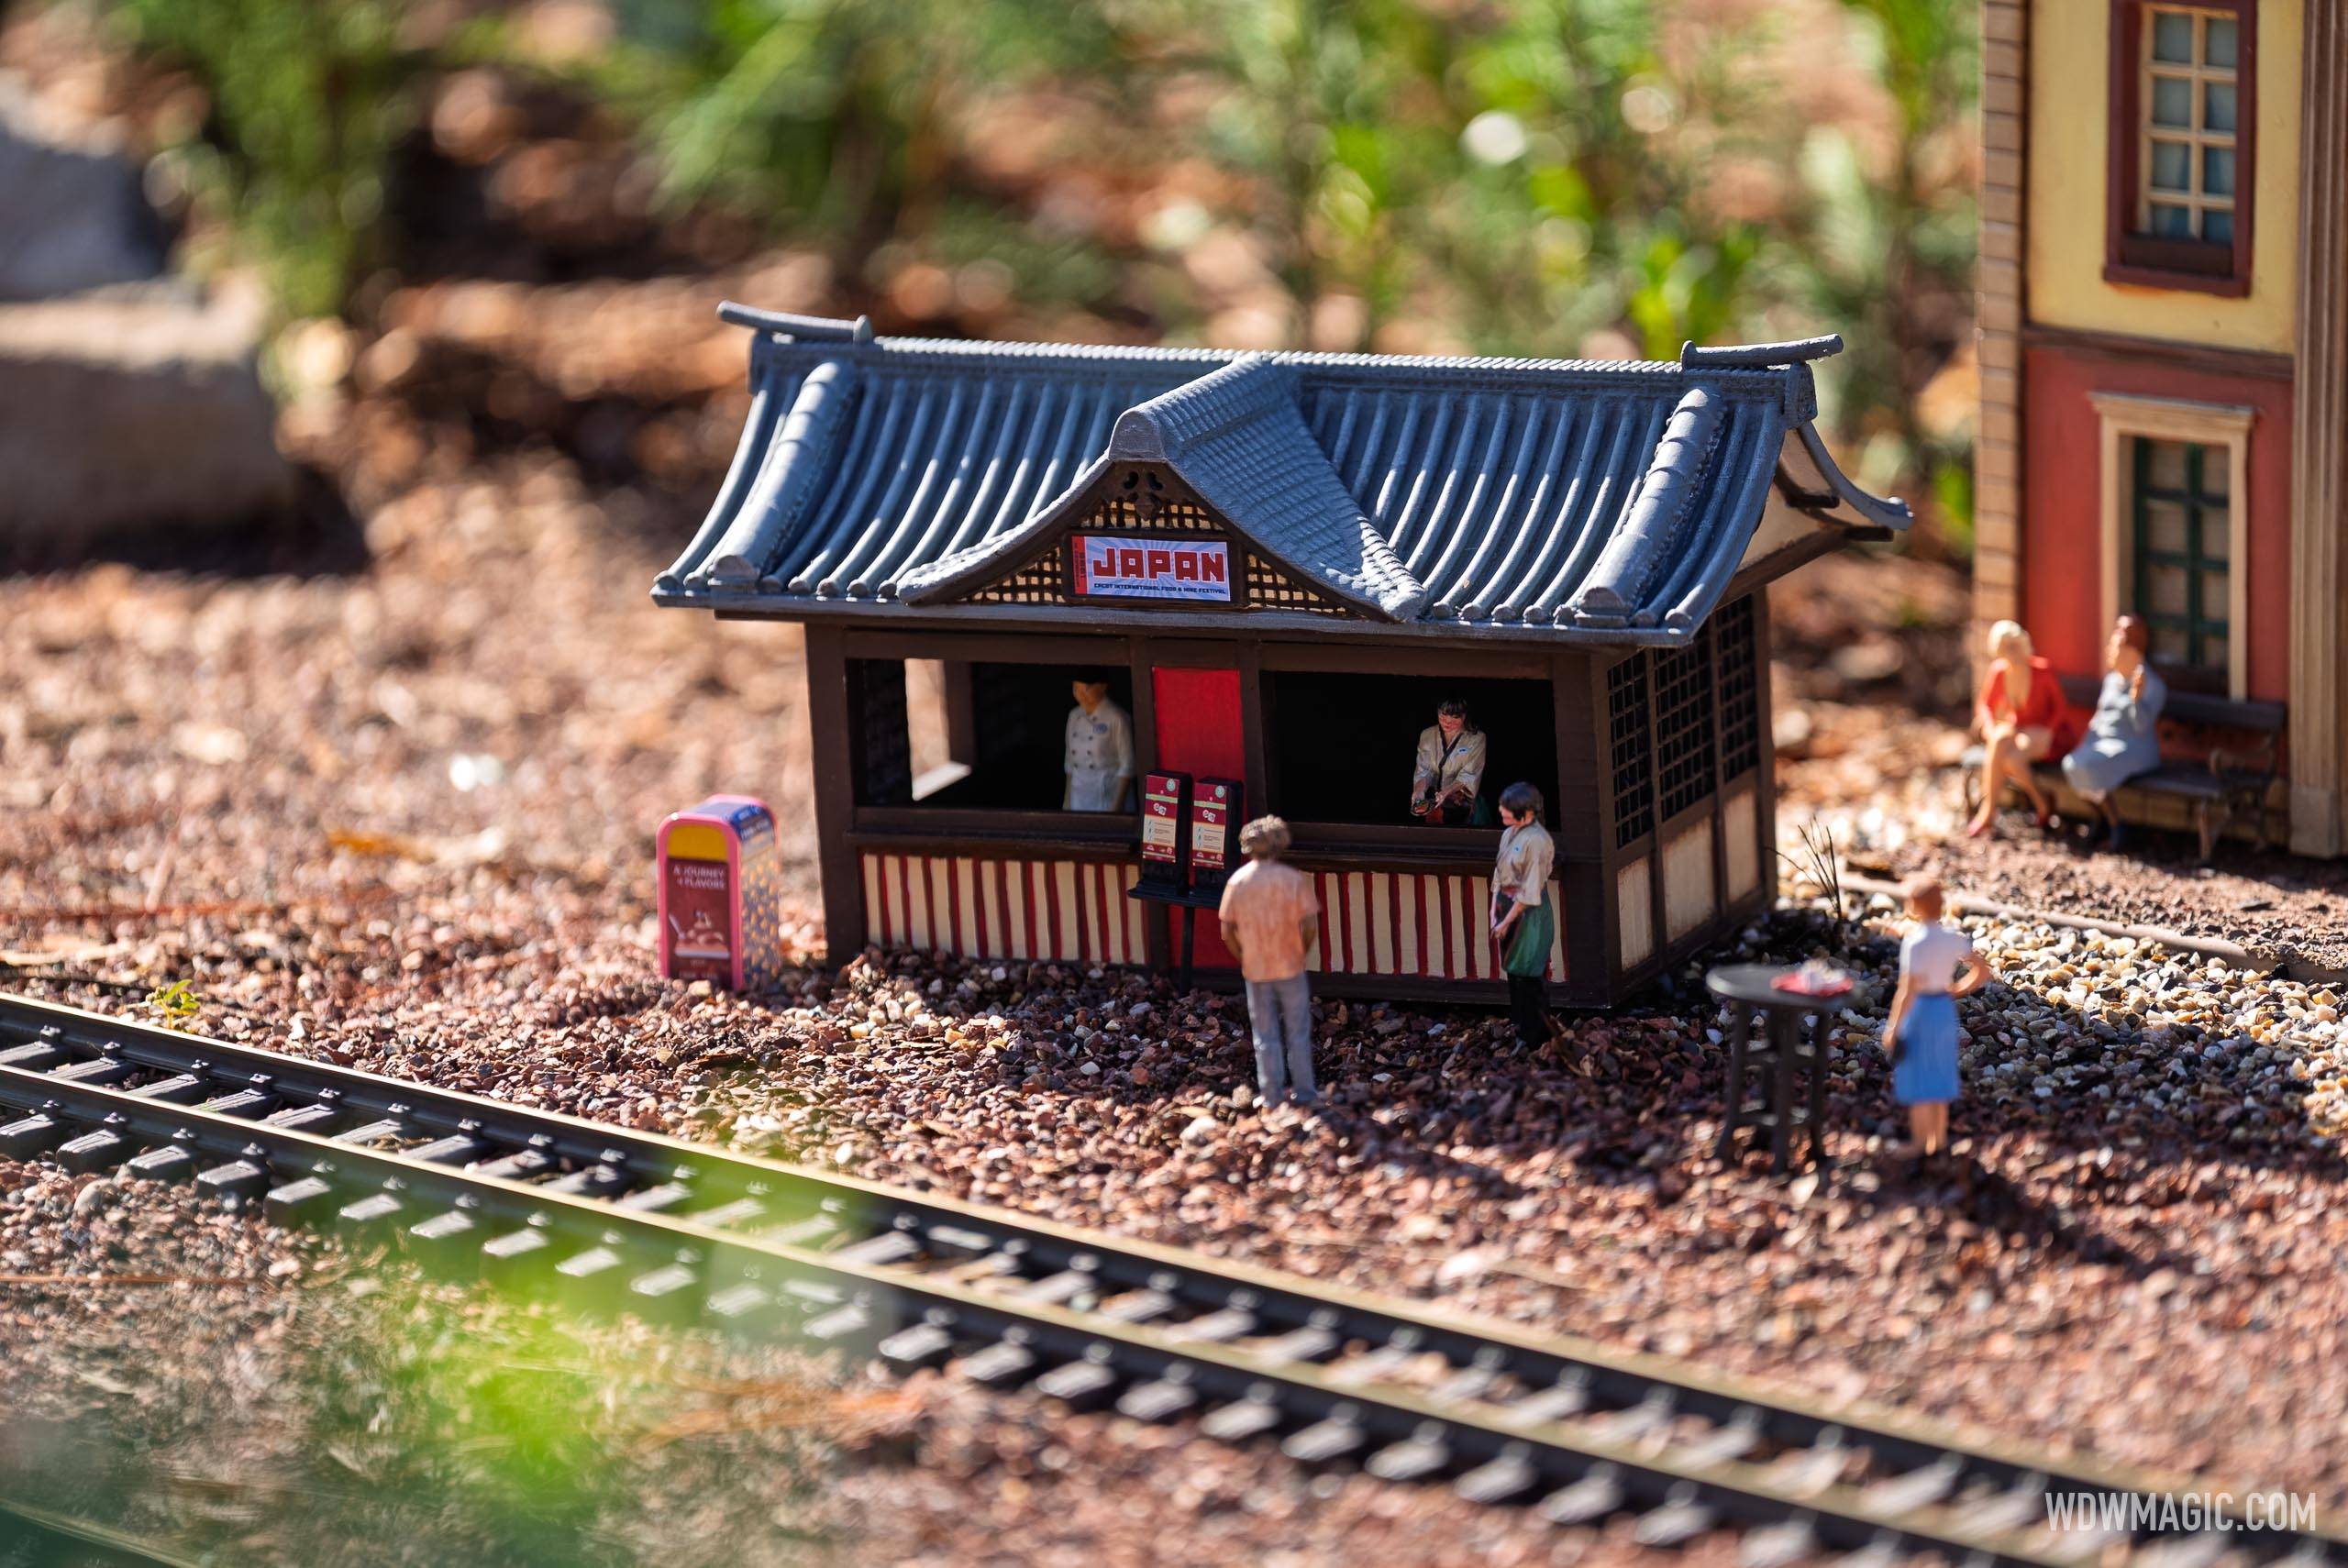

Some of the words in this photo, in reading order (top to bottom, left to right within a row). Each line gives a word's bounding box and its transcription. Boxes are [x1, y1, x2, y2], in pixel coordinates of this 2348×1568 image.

[1092, 547, 1225, 582] JAPAN
[673, 865, 681, 875] A
[683, 866, 724, 878] JOURNEY
[684, 878, 725, 889] FLAVORS
